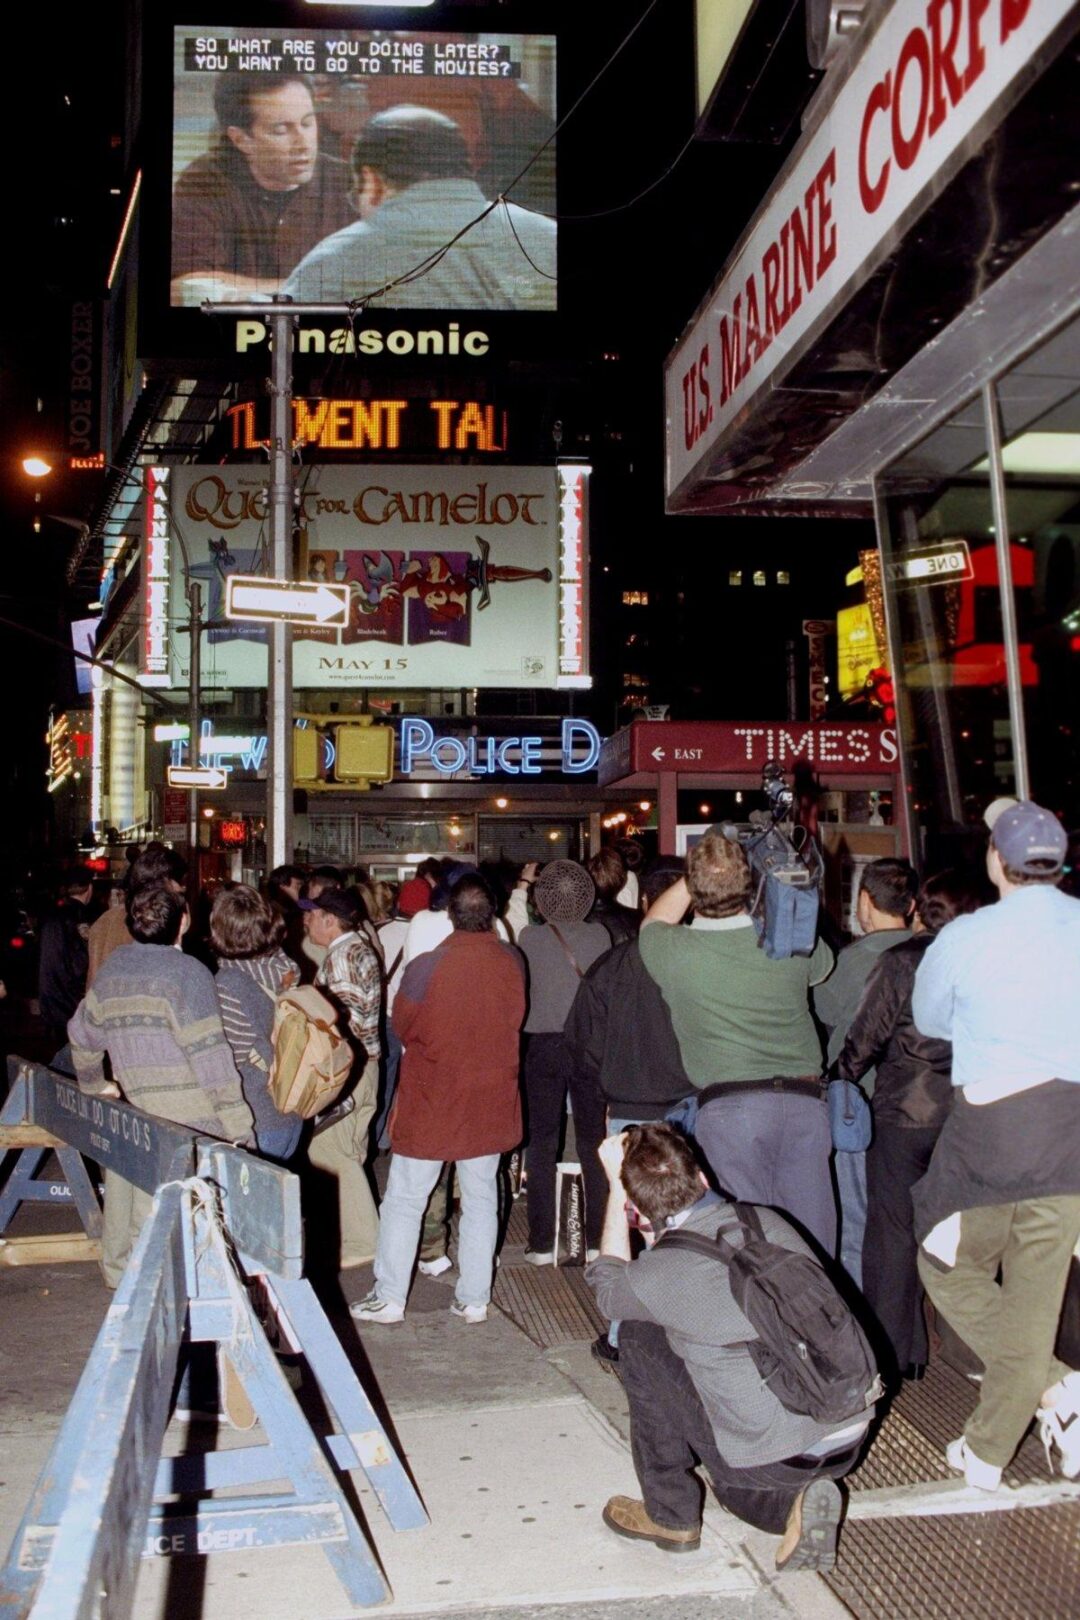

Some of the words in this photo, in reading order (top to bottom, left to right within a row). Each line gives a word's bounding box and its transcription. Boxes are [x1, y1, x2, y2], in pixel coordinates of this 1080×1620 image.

[195, 37, 217, 53] SO
[228, 38, 271, 54] WHAT
[282, 40, 316, 55] ARE
[325, 41, 358, 56] YOU
[369, 42, 424, 57] DOING
[434, 43, 499, 59] LATER?
[195, 54, 228, 70] YOU
[238, 56, 282, 71] WANT
[294, 57, 316, 71] TO
[326, 58, 348, 73] GO
[359, 58, 380, 73] TO
[391, 59, 424, 74] THE
[434, 61, 510, 77] MOVIES?
[683, 343, 713, 451] U.S.
[719, 147, 837, 408] MARINE
[858, 0, 1032, 214] CORP
[236, 320, 489, 356] Pnasonic
[70, 398, 92, 450] JOE
[226, 400, 407, 449] TLMENT
[384, 657, 409, 670] 15
[401, 718, 543, 774] POLICE
[674, 748, 703, 760] EAST
[734, 728, 871, 763] TIMES
